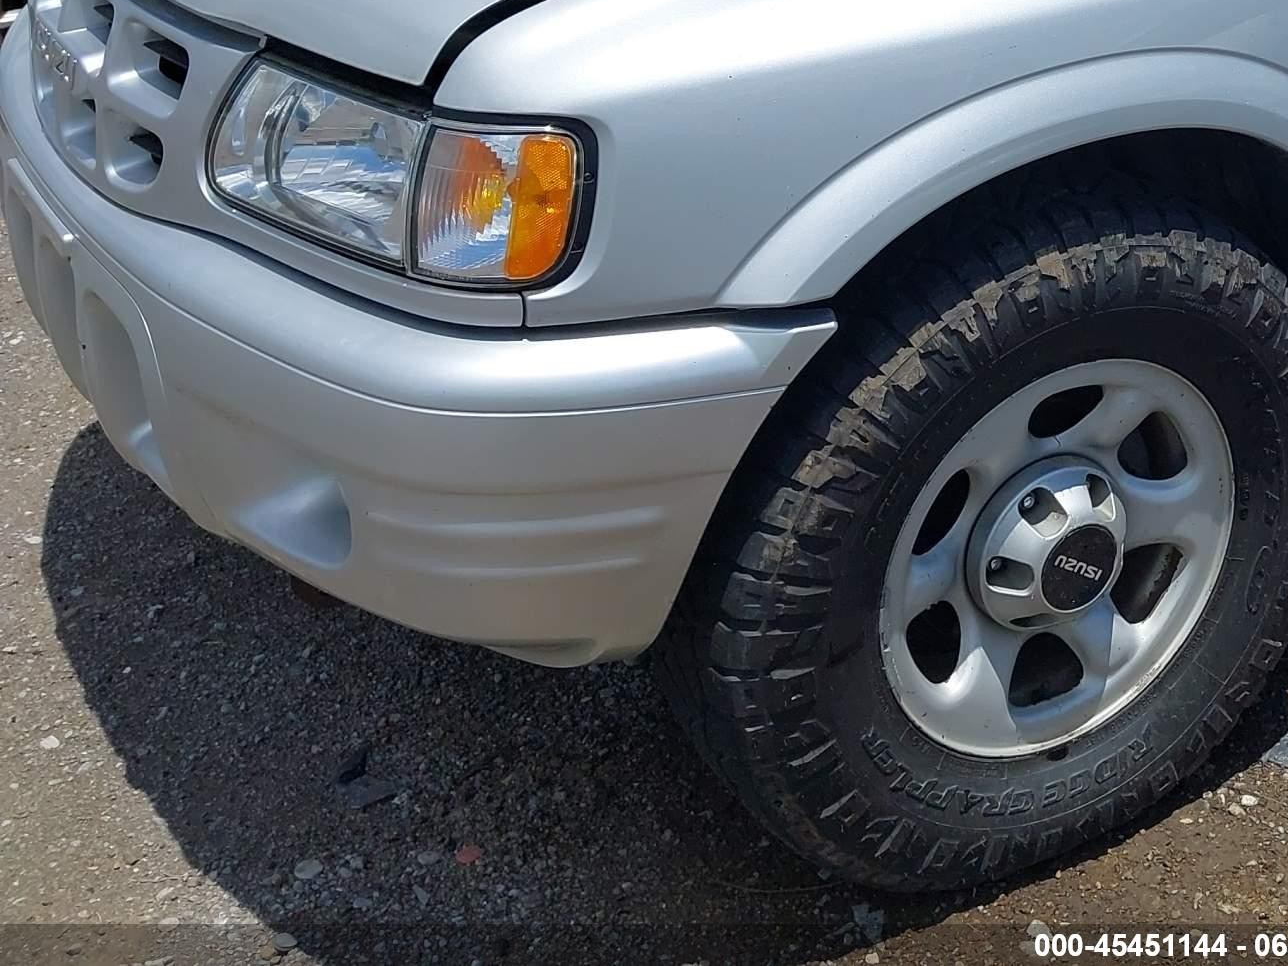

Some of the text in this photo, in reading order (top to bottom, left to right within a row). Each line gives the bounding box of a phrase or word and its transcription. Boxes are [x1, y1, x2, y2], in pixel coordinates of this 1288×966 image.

[1054, 554, 1103, 581] ISUZU
[860, 720, 1156, 818] RIDGE GRAPPLER
